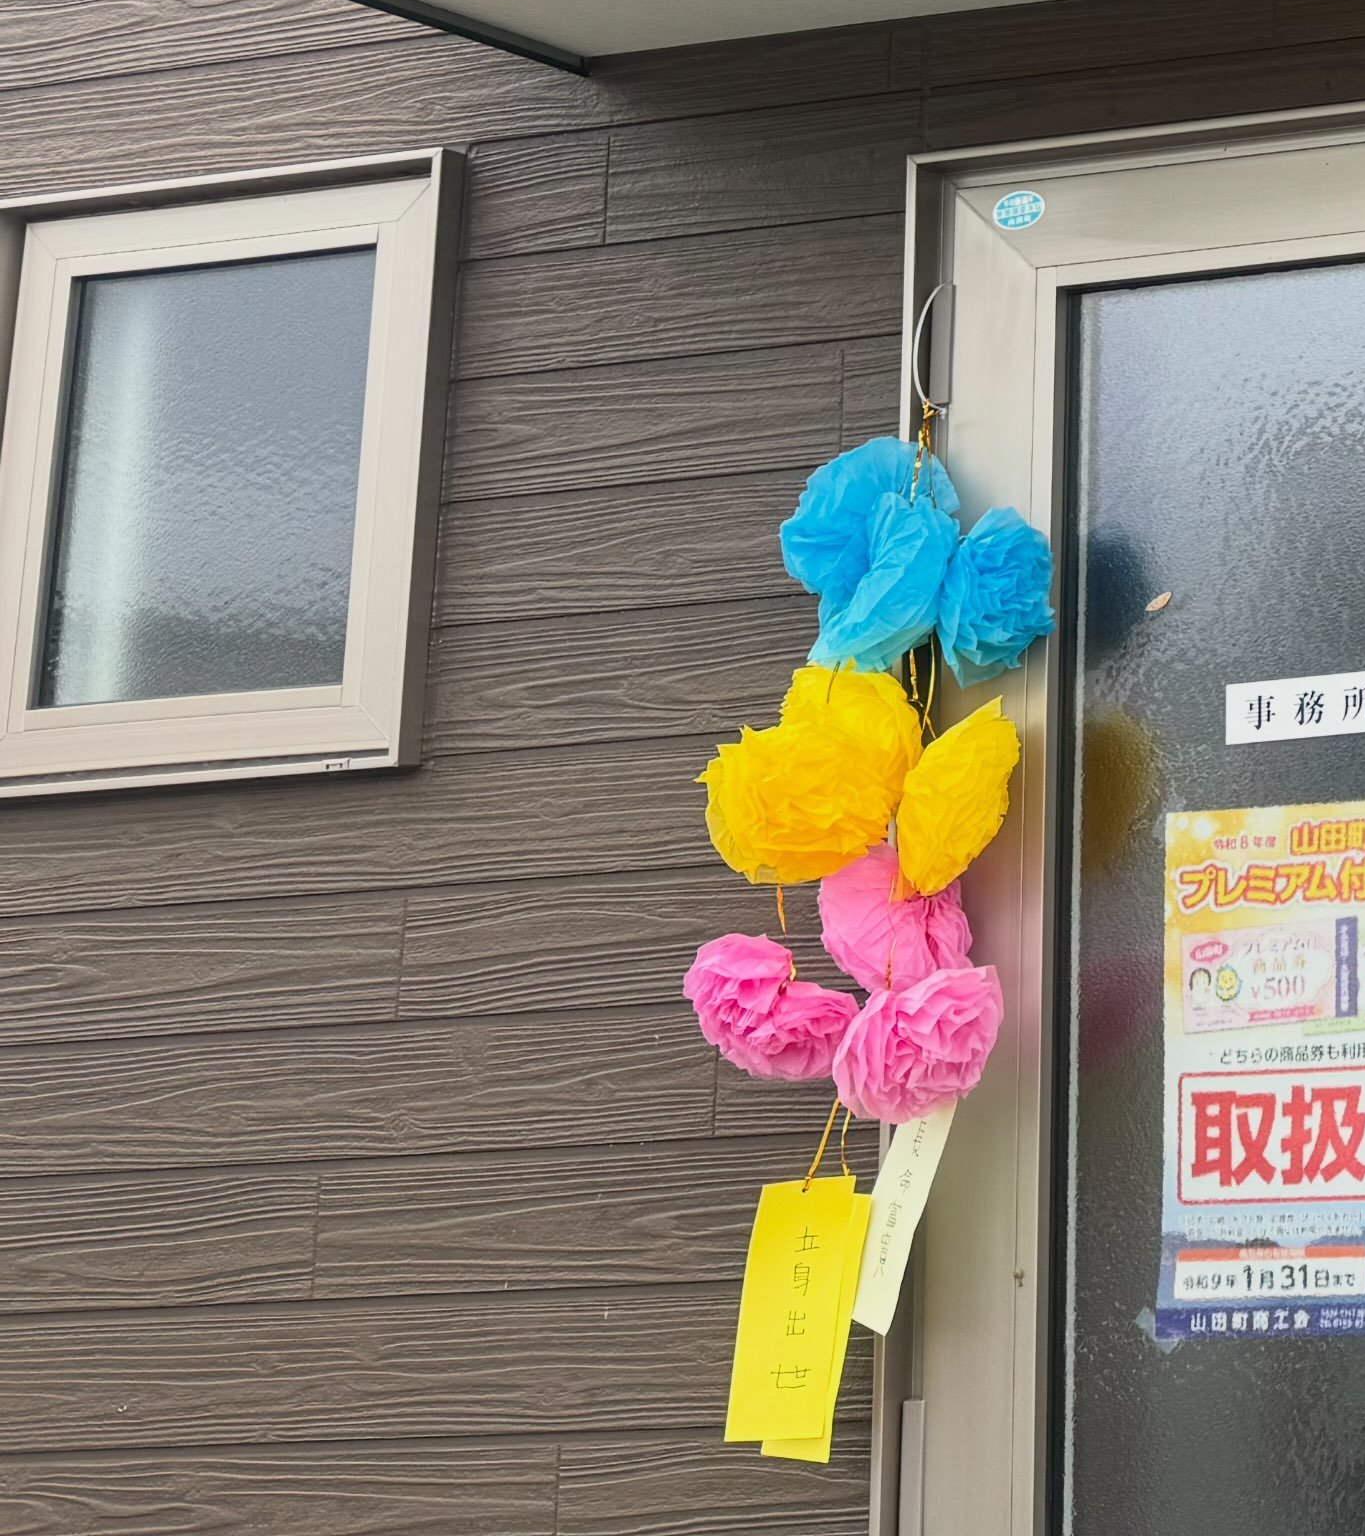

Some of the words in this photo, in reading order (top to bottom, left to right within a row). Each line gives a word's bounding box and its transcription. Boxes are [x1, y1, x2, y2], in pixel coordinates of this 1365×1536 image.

[1182, 1263, 1357, 1292] 令和9年1月31日まで
[1190, 1309, 1311, 1332] 山田町商工会
